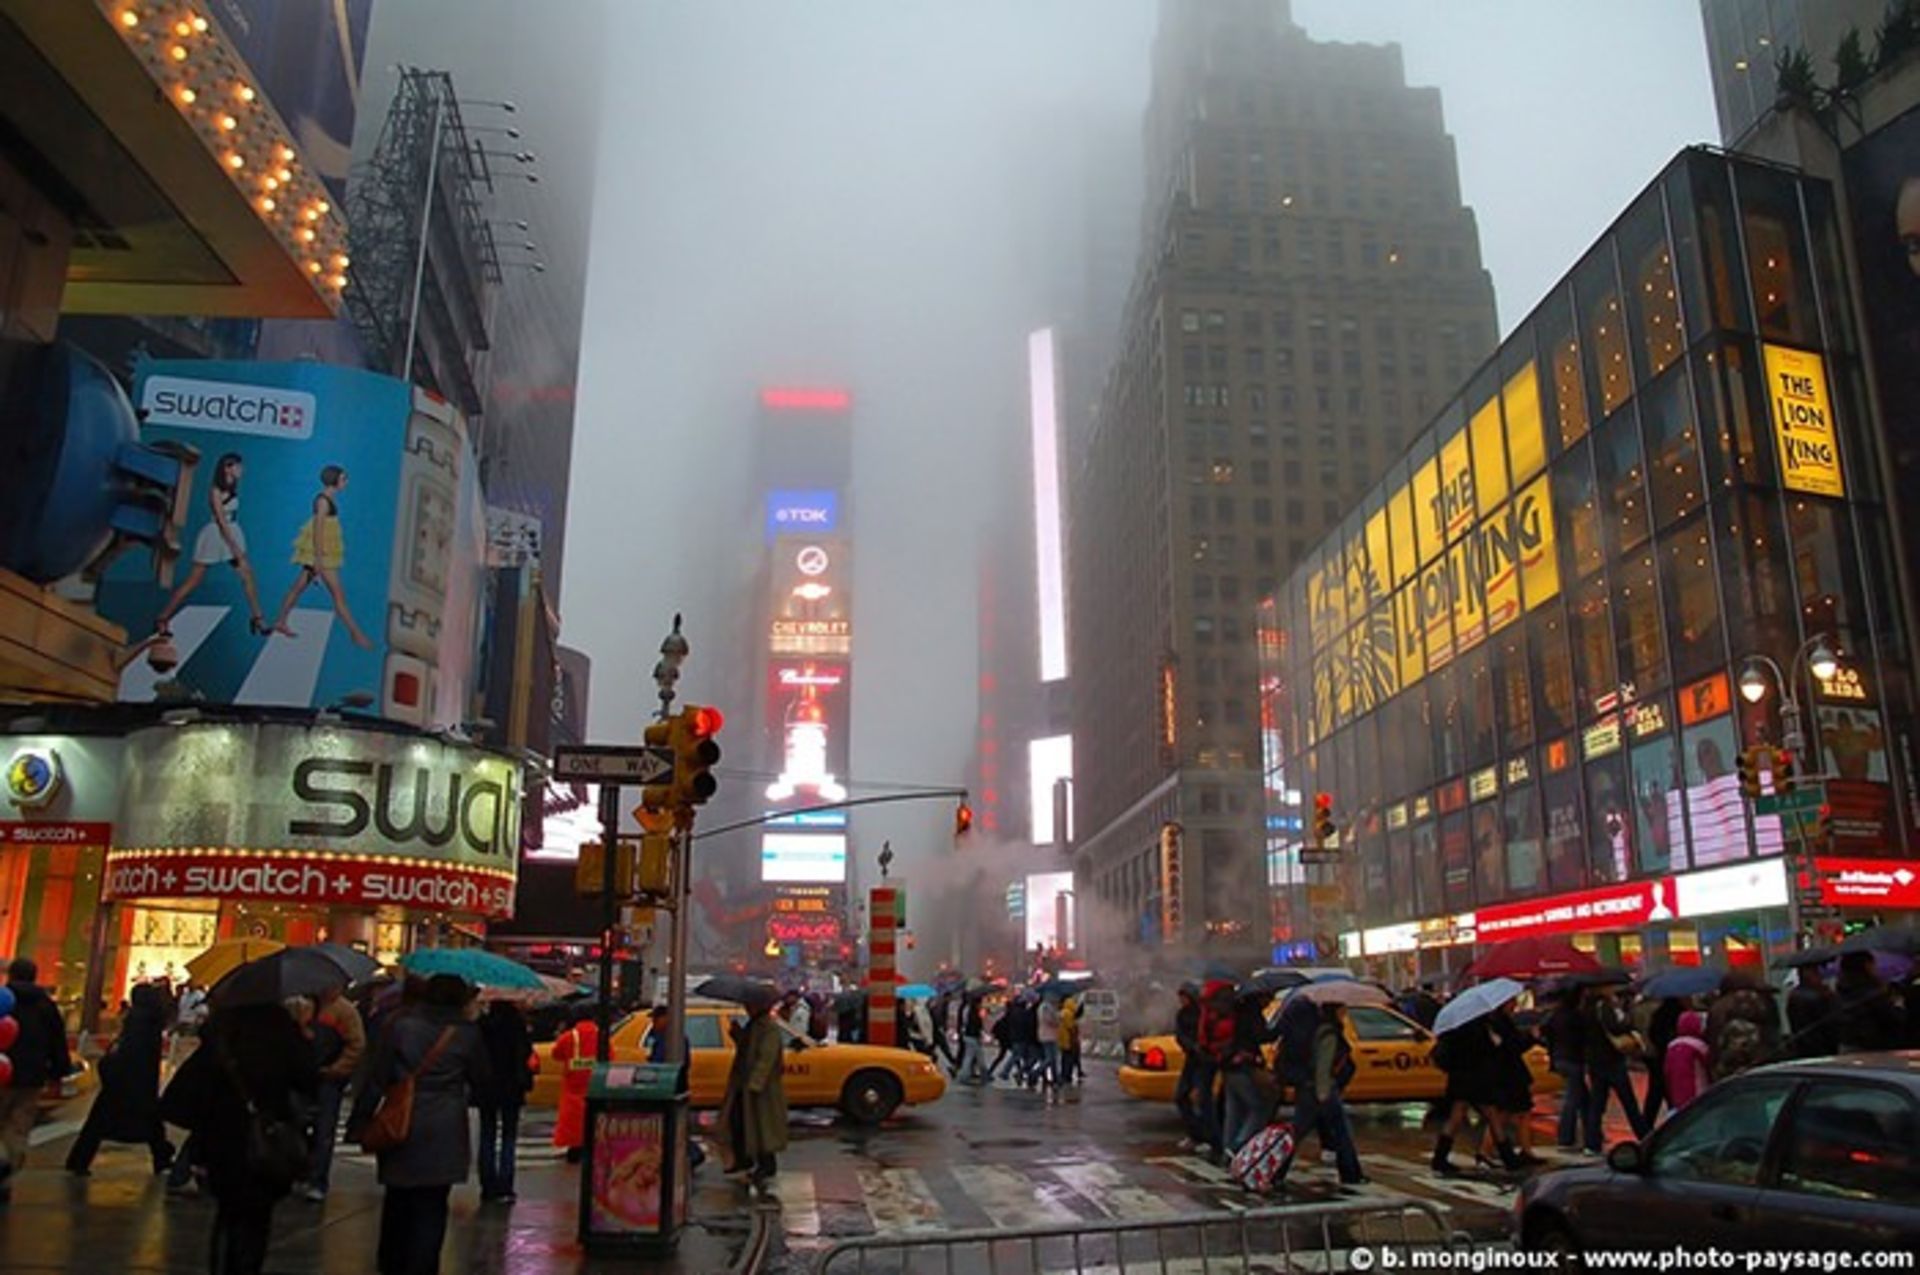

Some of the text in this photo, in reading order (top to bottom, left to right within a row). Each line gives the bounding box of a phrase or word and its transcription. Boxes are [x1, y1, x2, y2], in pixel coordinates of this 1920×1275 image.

[1779, 372, 1815, 396] THE
[154, 391, 278, 426] swatch
[1778, 397, 1825, 431] LION
[1784, 436, 1832, 470] KING
[790, 508, 828, 522] TDK
[1430, 468, 1473, 533] THE
[1400, 555, 1462, 658] LION
[1460, 495, 1543, 615] KING
[772, 621, 849, 635] CHEVROLET
[570, 757, 660, 774] ONE WAY
[13, 826, 77, 841] swatch
[183, 862, 327, 896] swatch
[361, 874, 479, 908] swatch
